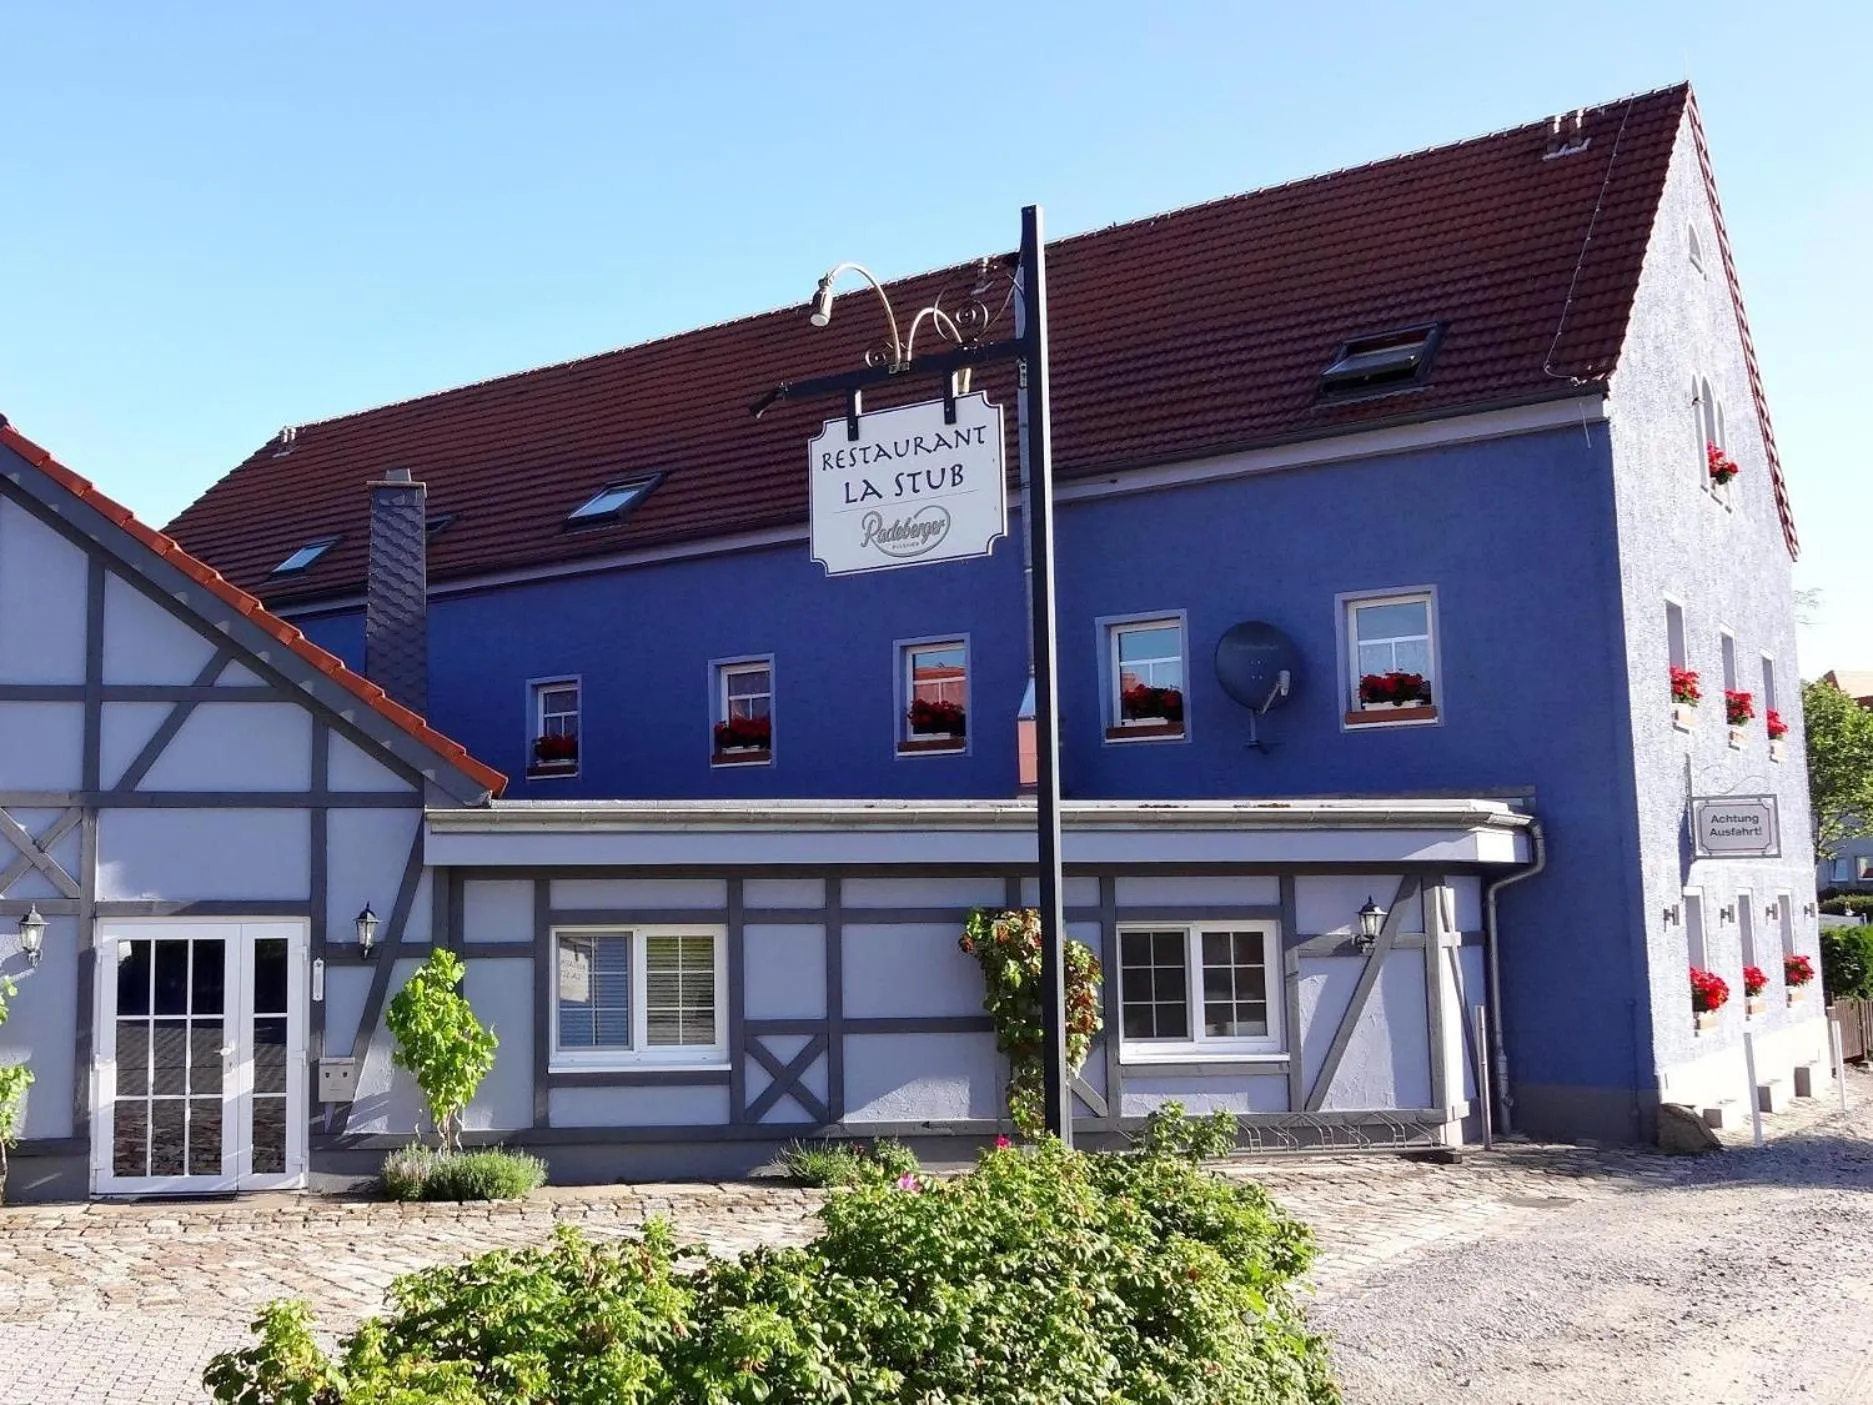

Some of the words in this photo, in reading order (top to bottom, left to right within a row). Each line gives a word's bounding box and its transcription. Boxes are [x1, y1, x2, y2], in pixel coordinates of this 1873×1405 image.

[822, 425, 987, 471] RESTAURANT
[844, 479, 883, 504] LA
[894, 464, 965, 497] STUB
[861, 510, 946, 548] Radeberger
[1709, 826, 1763, 837] Ausfahrt!
[1711, 814, 1760, 824] Achtung
